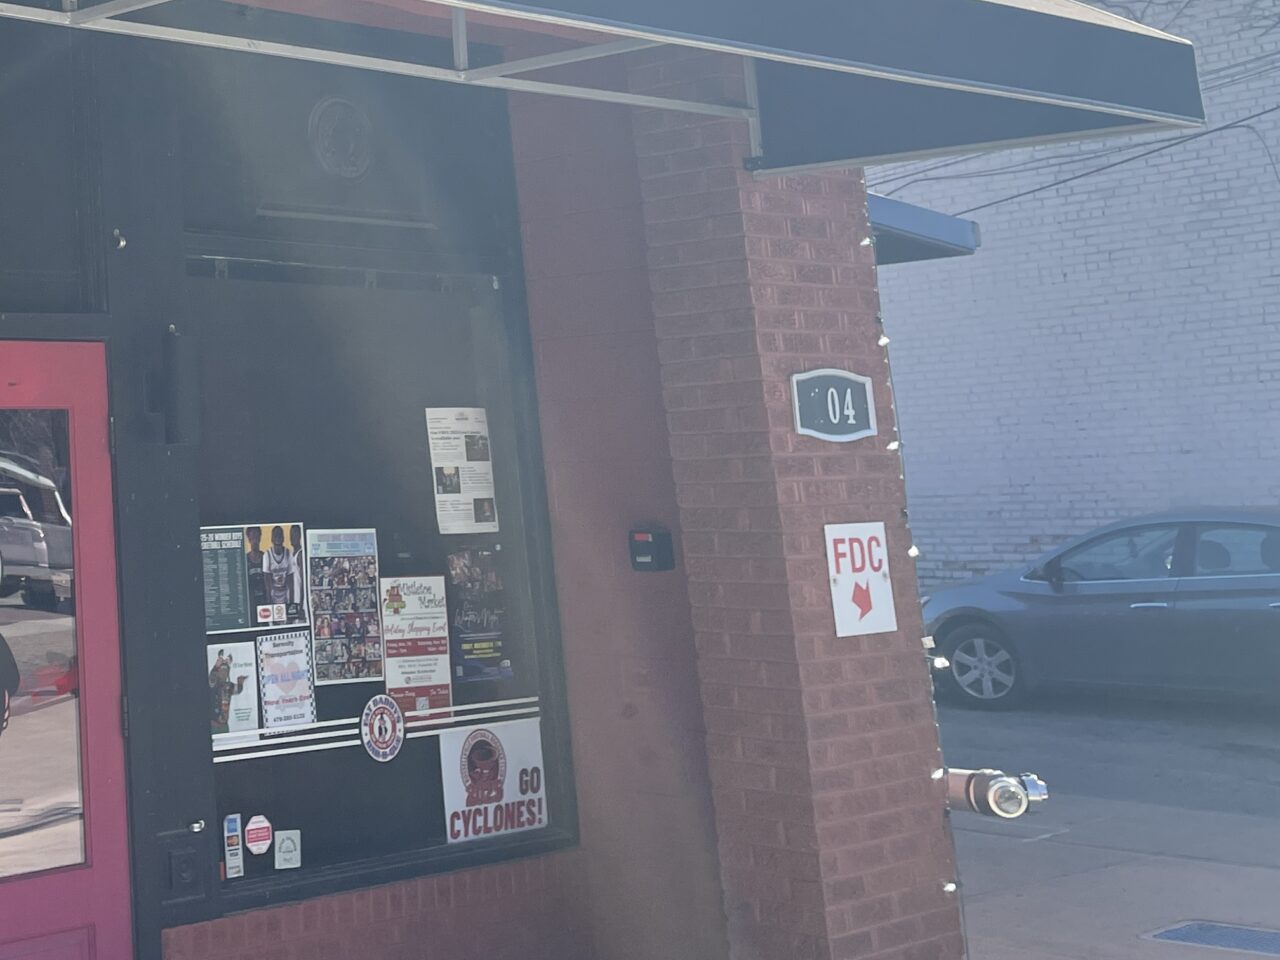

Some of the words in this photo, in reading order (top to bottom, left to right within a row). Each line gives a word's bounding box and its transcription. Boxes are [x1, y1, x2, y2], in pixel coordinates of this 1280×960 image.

[827, 387, 856, 424] 04
[833, 536, 884, 574] FDC
[519, 766, 541, 796] GO
[450, 797, 543, 840] CYCLONES!
